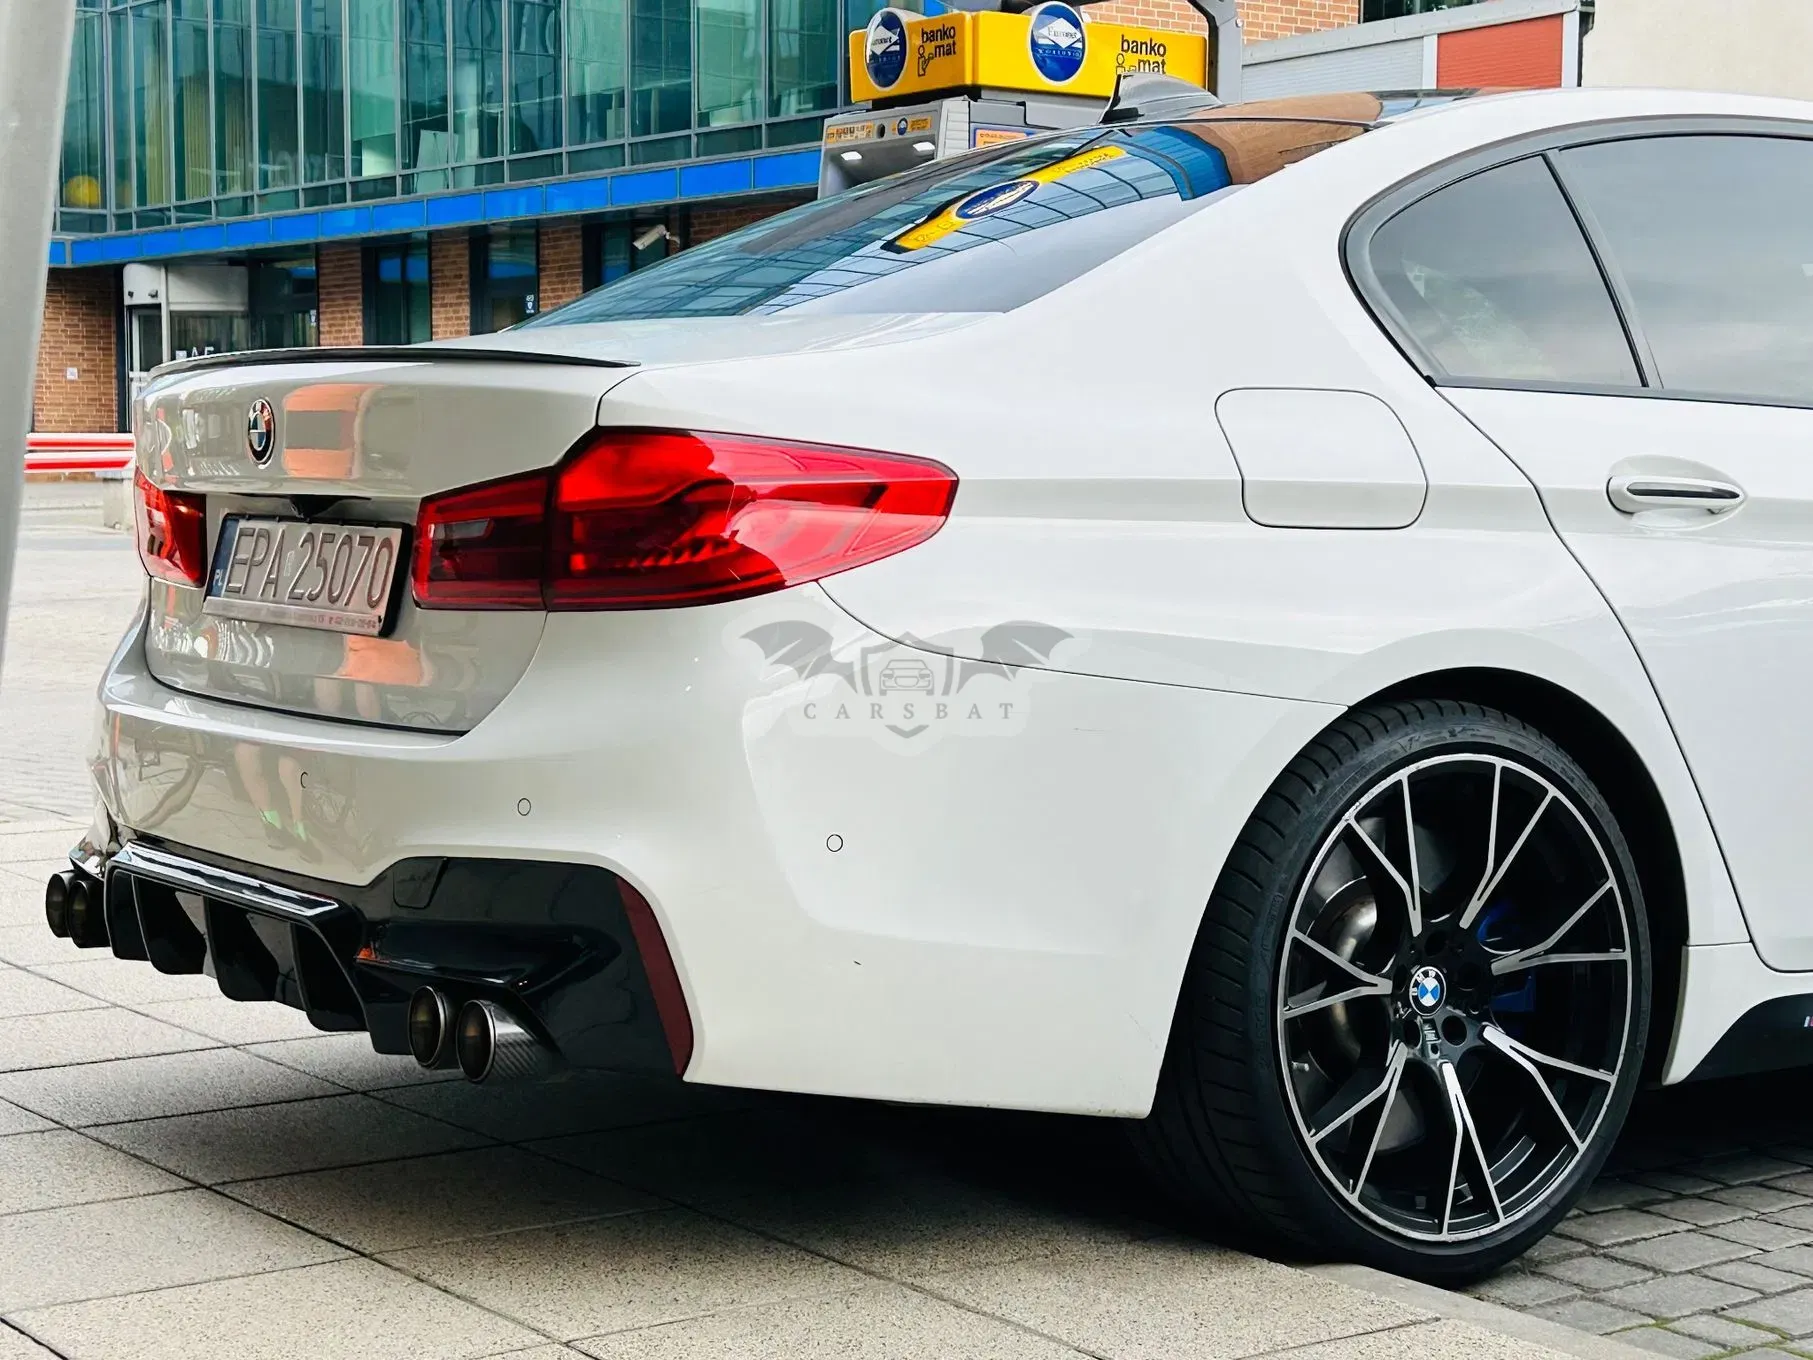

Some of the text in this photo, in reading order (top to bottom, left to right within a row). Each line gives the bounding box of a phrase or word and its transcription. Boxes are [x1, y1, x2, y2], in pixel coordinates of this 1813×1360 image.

[921, 24, 956, 44] banko
[934, 40, 957, 58] mat
[1121, 34, 1167, 57] banko
[1137, 58, 1167, 74] mat
[226, 527, 394, 609] EPA 25070
